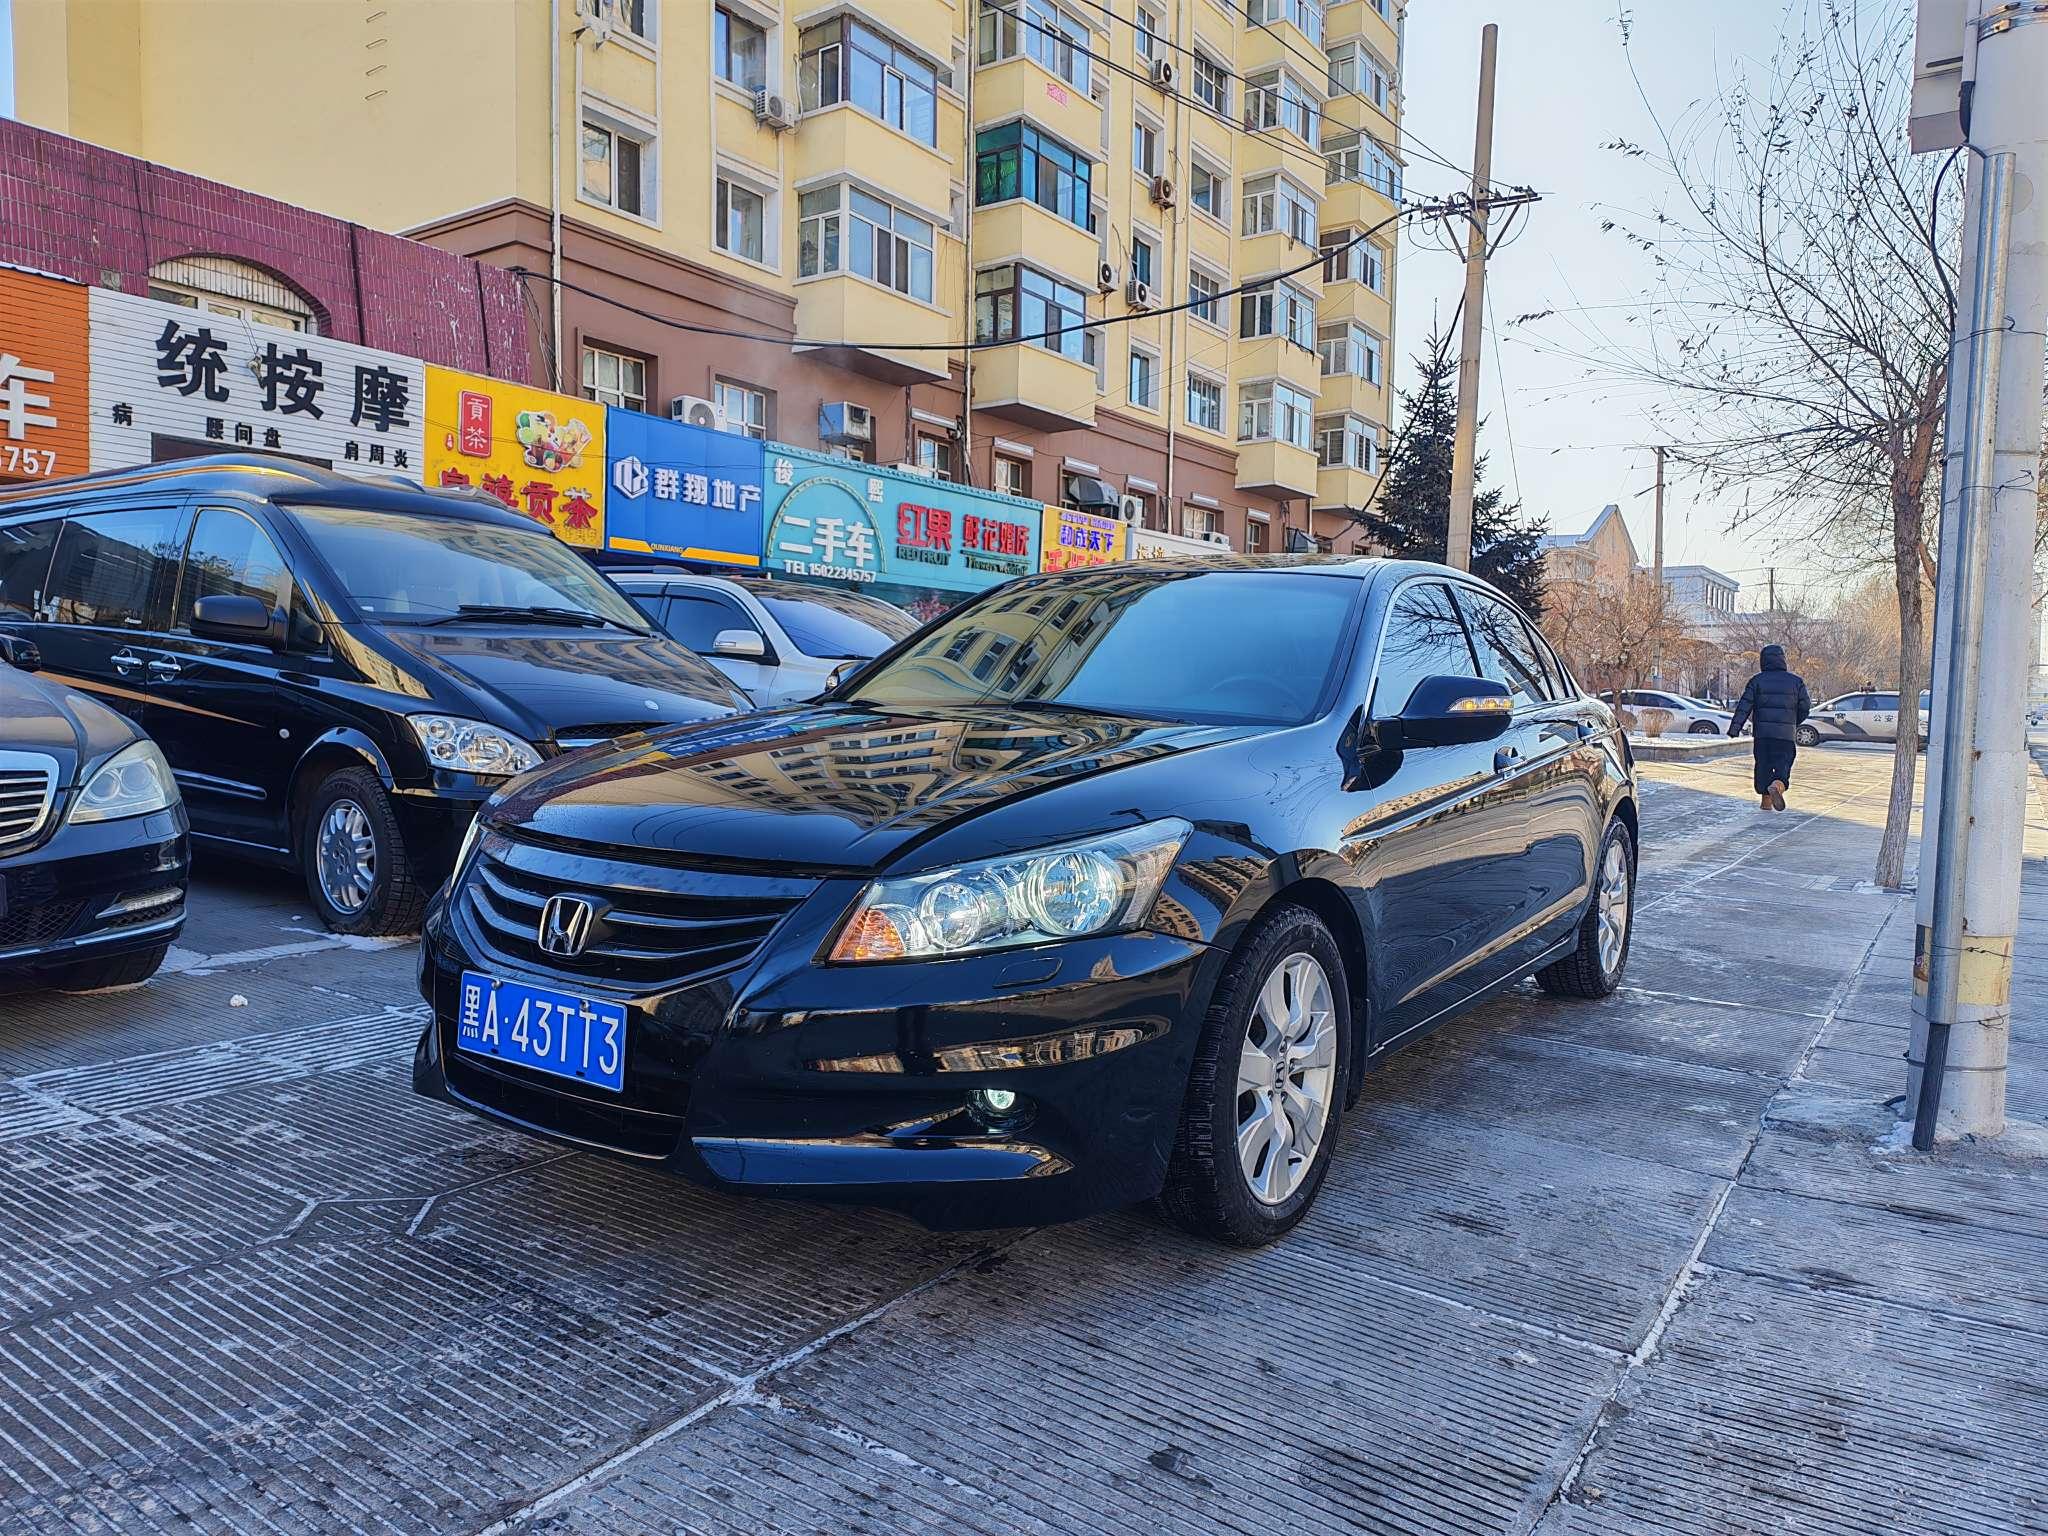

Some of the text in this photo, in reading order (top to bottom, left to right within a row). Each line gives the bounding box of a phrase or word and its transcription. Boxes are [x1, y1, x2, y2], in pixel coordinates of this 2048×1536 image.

[156, 319, 410, 432] 统按摩
[113, 402, 133, 426] 病
[206, 417, 282, 448] 腰间盘
[344, 441, 409, 468] 肩周炎
[654, 467, 761, 512] 群翔地产
[779, 515, 875, 567] 二手车
[896, 502, 952, 551] 红果
[784, 559, 809, 576] TEL
[1873, 714, 1894, 722] 公安
